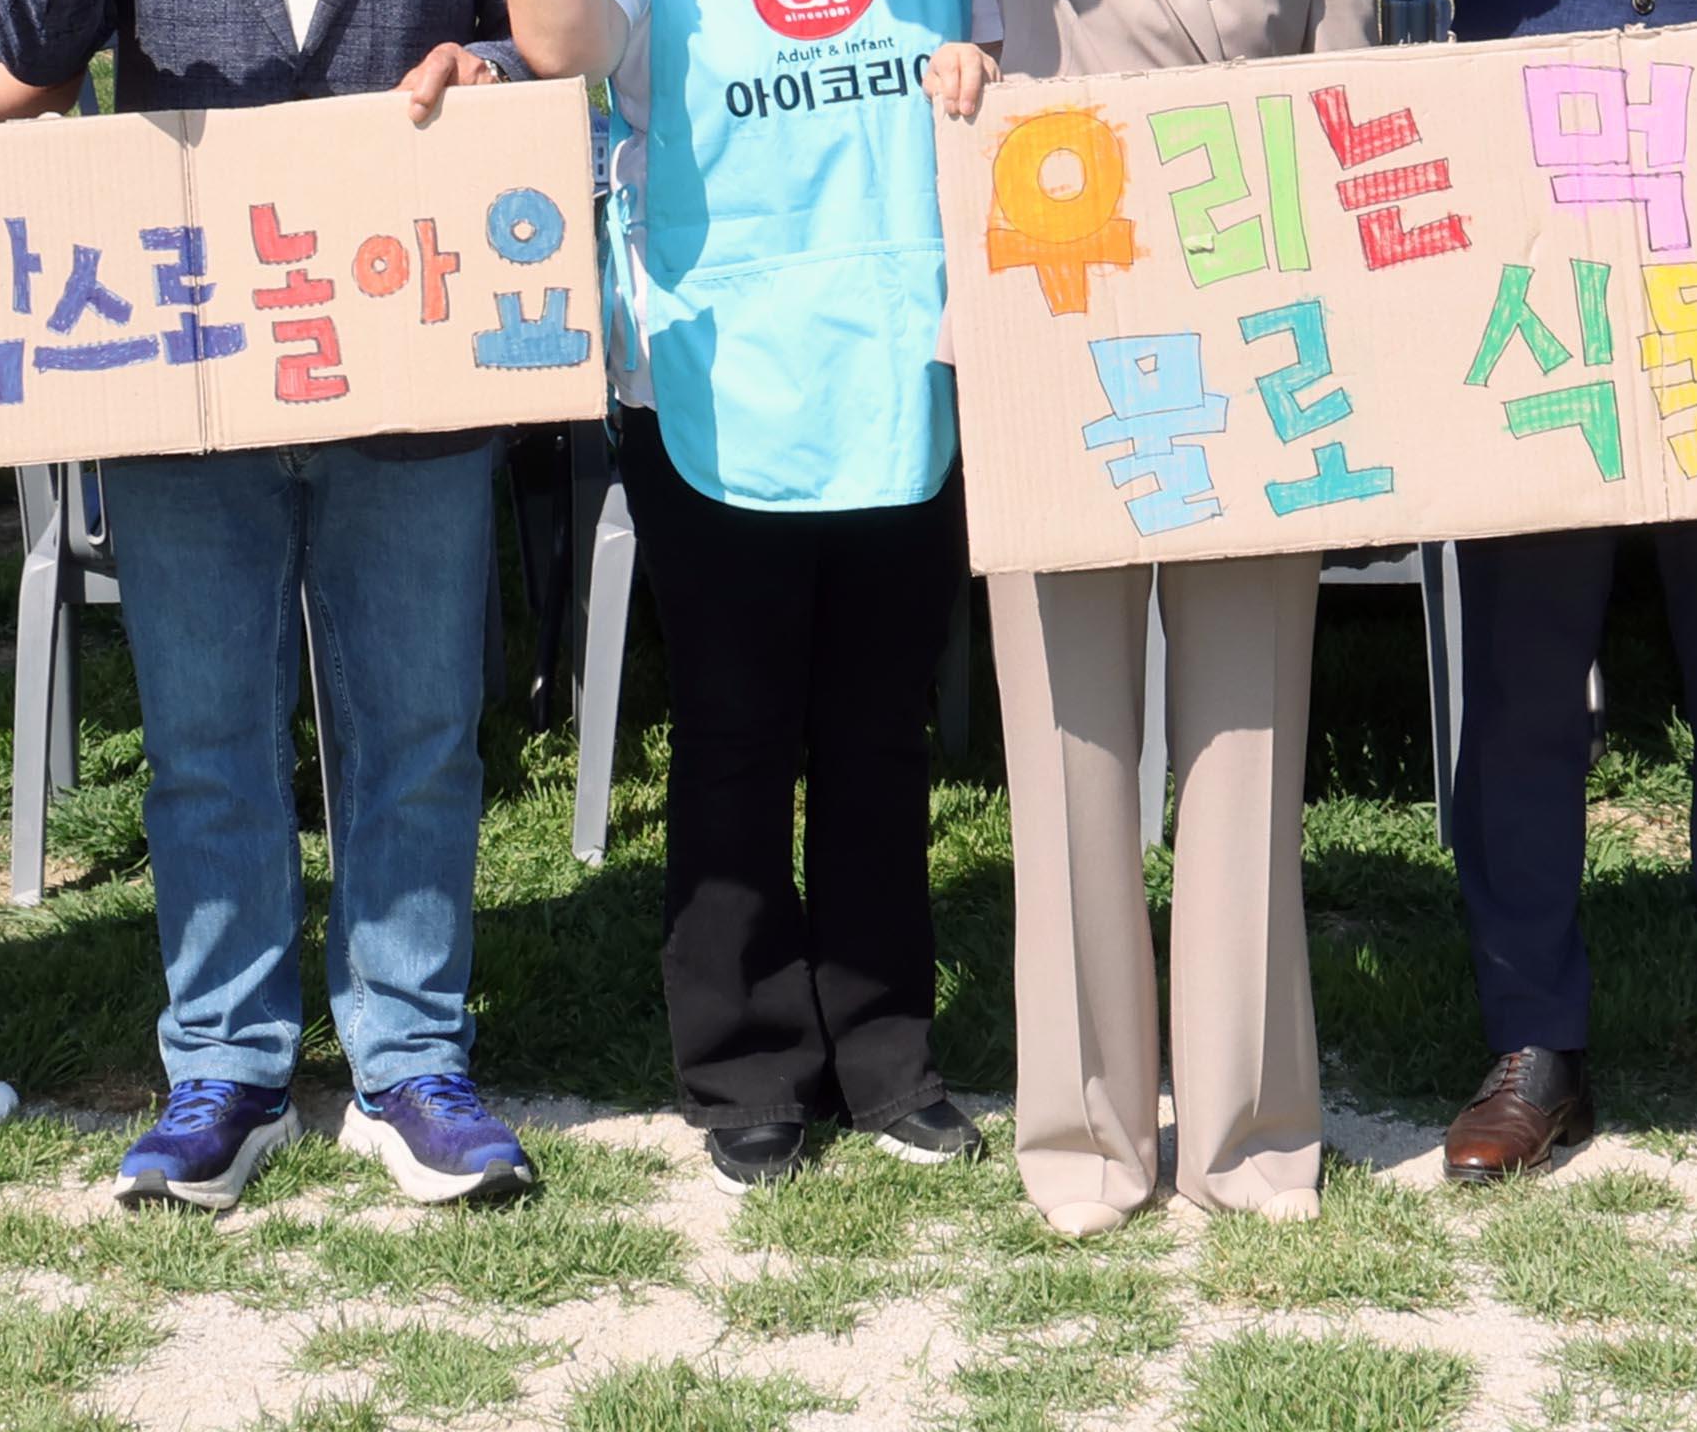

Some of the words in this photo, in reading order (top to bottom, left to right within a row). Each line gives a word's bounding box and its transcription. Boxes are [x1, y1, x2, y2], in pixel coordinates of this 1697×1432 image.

[776, 46, 823, 65] Adult
[828, 44, 840, 56] &
[845, 36, 896, 54] Infant
[249, 186, 592, 405] 놀아요
[986, 84, 1473, 317] 우리는
[1081, 299, 1395, 537] 물로
